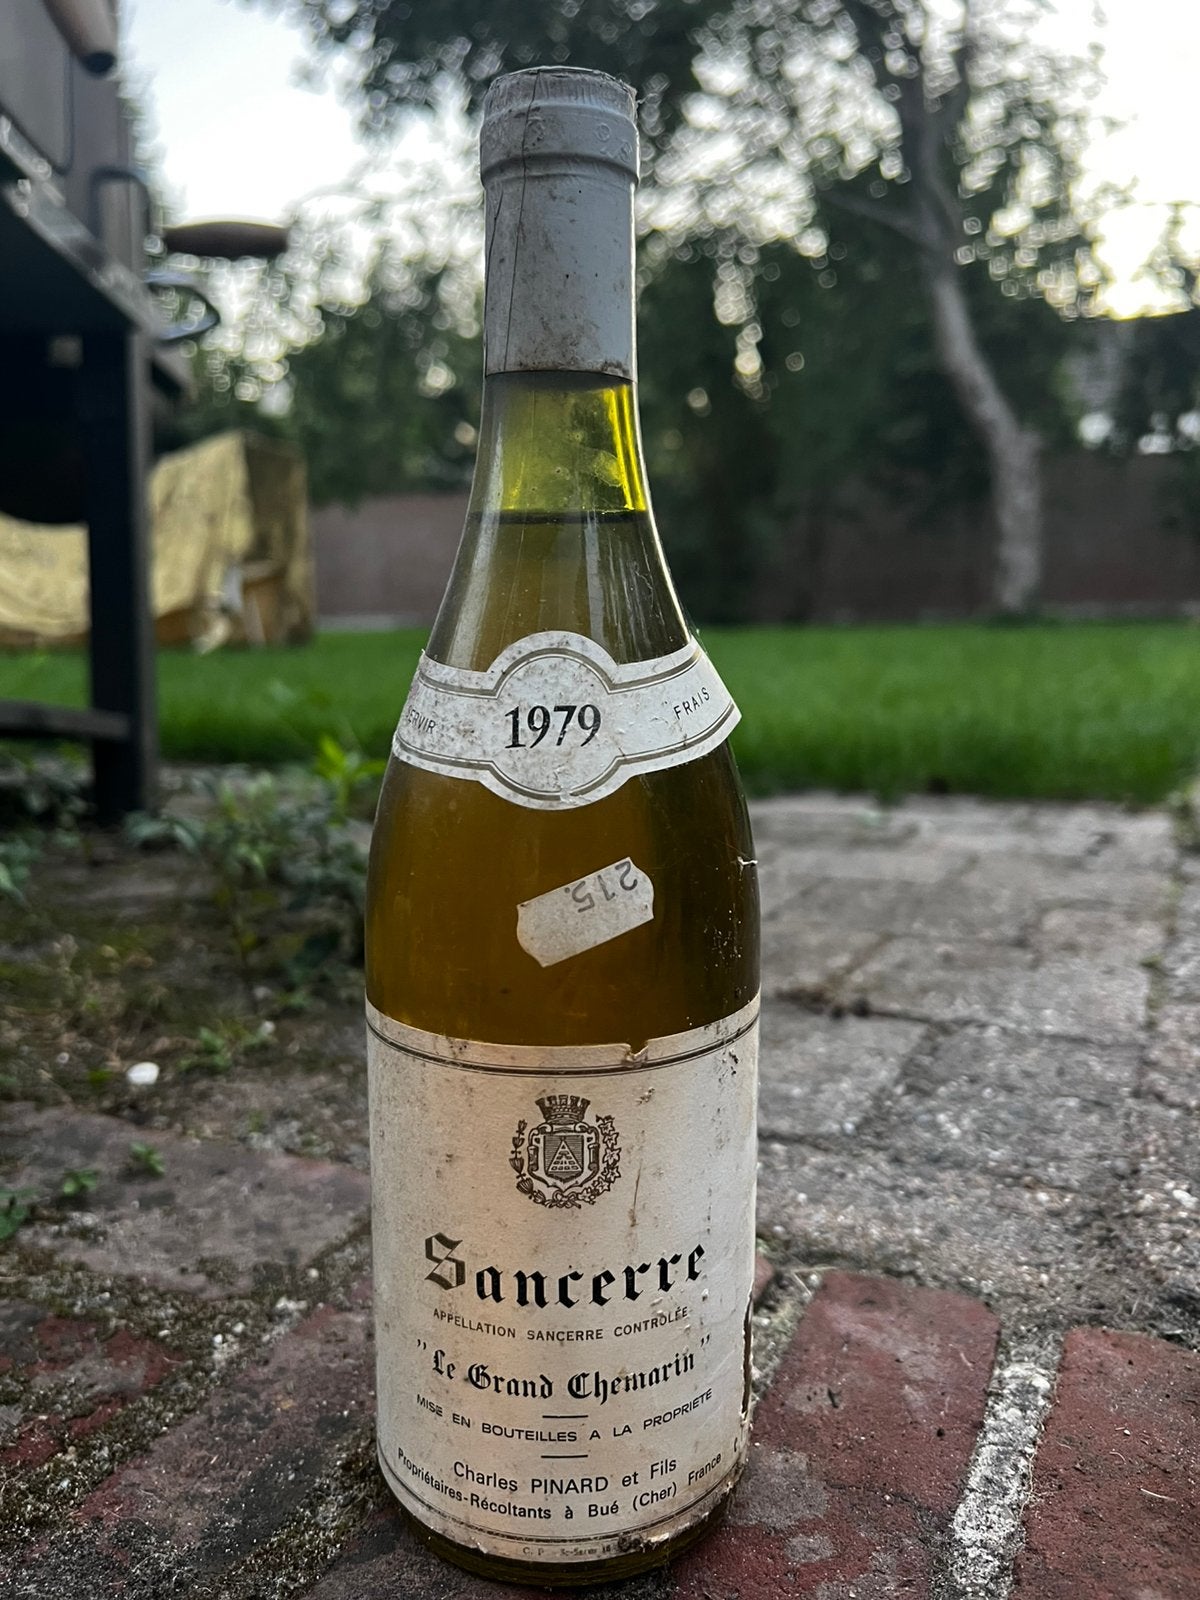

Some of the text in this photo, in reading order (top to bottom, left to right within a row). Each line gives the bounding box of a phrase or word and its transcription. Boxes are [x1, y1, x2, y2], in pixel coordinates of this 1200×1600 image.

[673, 686, 710, 720] FRAIS
[504, 704, 602, 749] 1979
[424, 1232, 706, 1309] Sancerre
[433, 1307, 516, 1338] APPELLATION
[527, 1329, 603, 1342] SANCERRE
[468, 1362, 553, 1399] Grand
[416, 1393, 443, 1417] MISE
[452, 1413, 471, 1428] EN
[482, 1423, 577, 1442] BOUTEILLES
[589, 1430, 601, 1440] A
[613, 1425, 632, 1437] LA
[398, 1447, 721, 1519] Propriétaires-Récoltants à Bué (Cher) France
[453, 1459, 677, 1495] Charles PINARD et Fils
